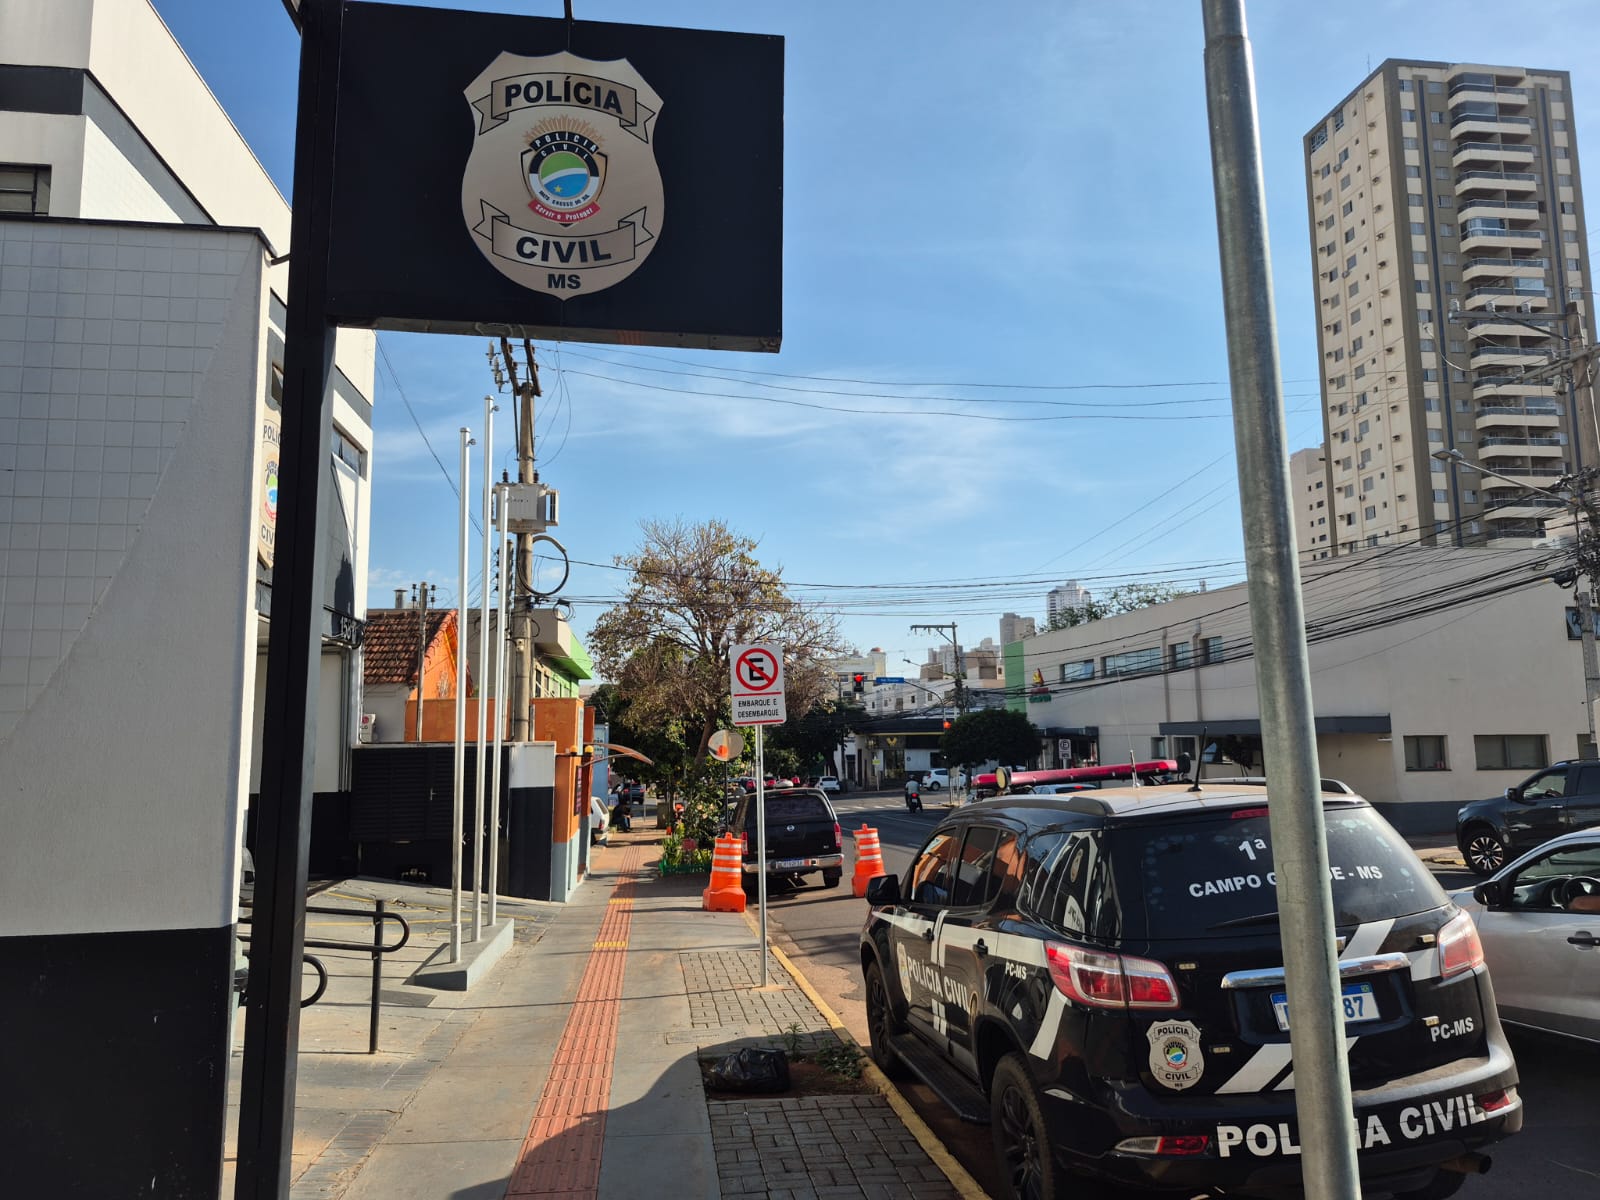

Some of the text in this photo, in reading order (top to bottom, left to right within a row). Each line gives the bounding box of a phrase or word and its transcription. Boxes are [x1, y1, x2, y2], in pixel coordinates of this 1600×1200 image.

[504, 76, 623, 114] POLÍCIA
[516, 236, 611, 263] CIVIL
[547, 274, 581, 290] MS
[737, 708, 779, 718] DESEMBARQUE
[738, 698, 777, 708] EMBARQUE E
[1189, 873, 1262, 898] CAMPO
[1355, 865, 1384, 880] MS
[1005, 961, 1027, 980] PC-MS
[907, 956, 972, 1016] POLÍCIA CIVIL
[1158, 1026, 1189, 1036] POLÍCIA
[1430, 1016, 1474, 1042] PC-MS
[1165, 1072, 1191, 1081] CIVIL
[1217, 1092, 1487, 1158] POLIA CIVIL
